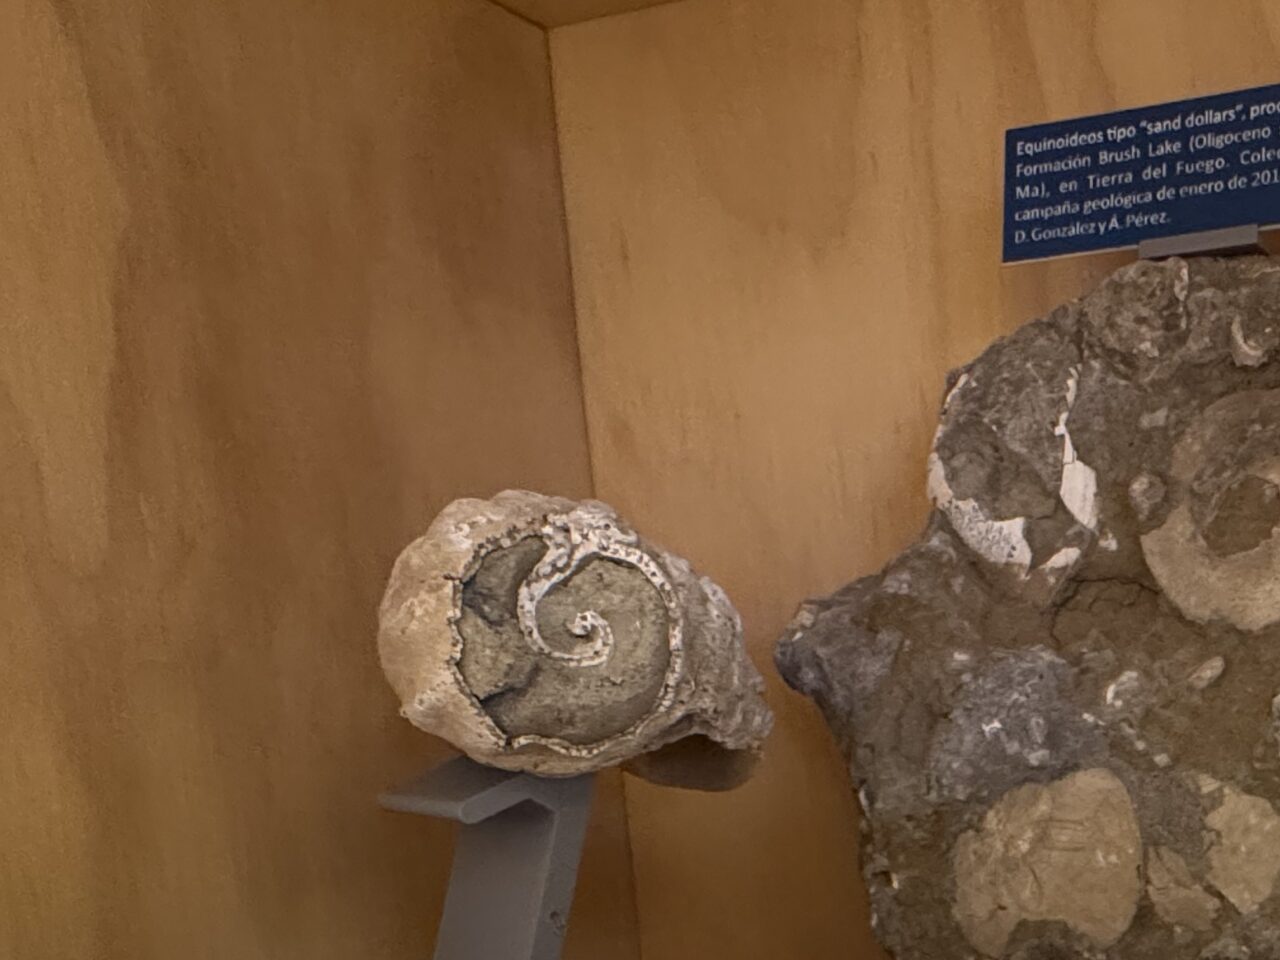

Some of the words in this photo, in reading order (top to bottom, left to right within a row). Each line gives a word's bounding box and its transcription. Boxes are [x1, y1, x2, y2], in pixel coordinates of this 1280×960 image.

[1015, 155, 1092, 178] Formación
[1098, 144, 1141, 165] Brush
[1148, 139, 1182, 158] Lake
[1188, 126, 1272, 153] (Oligoceno
[1016, 130, 1104, 156] Equinoideos
[1106, 125, 1137, 143] tipo
[1014, 200, 1080, 222] campaña
[1083, 191, 1153, 215] geológica
[1156, 185, 1176, 202] de
[1179, 180, 1225, 197] enero
[1227, 174, 1248, 190] de
[1015, 182, 1050, 200] Ma),
[1058, 180, 1078, 193] en
[1087, 171, 1133, 189] Tierra
[1141, 162, 1167, 181] del
[1176, 157, 1230, 175] Fuego.
[1014, 229, 1029, 244] D.
[1097, 221, 1107, 235] y
